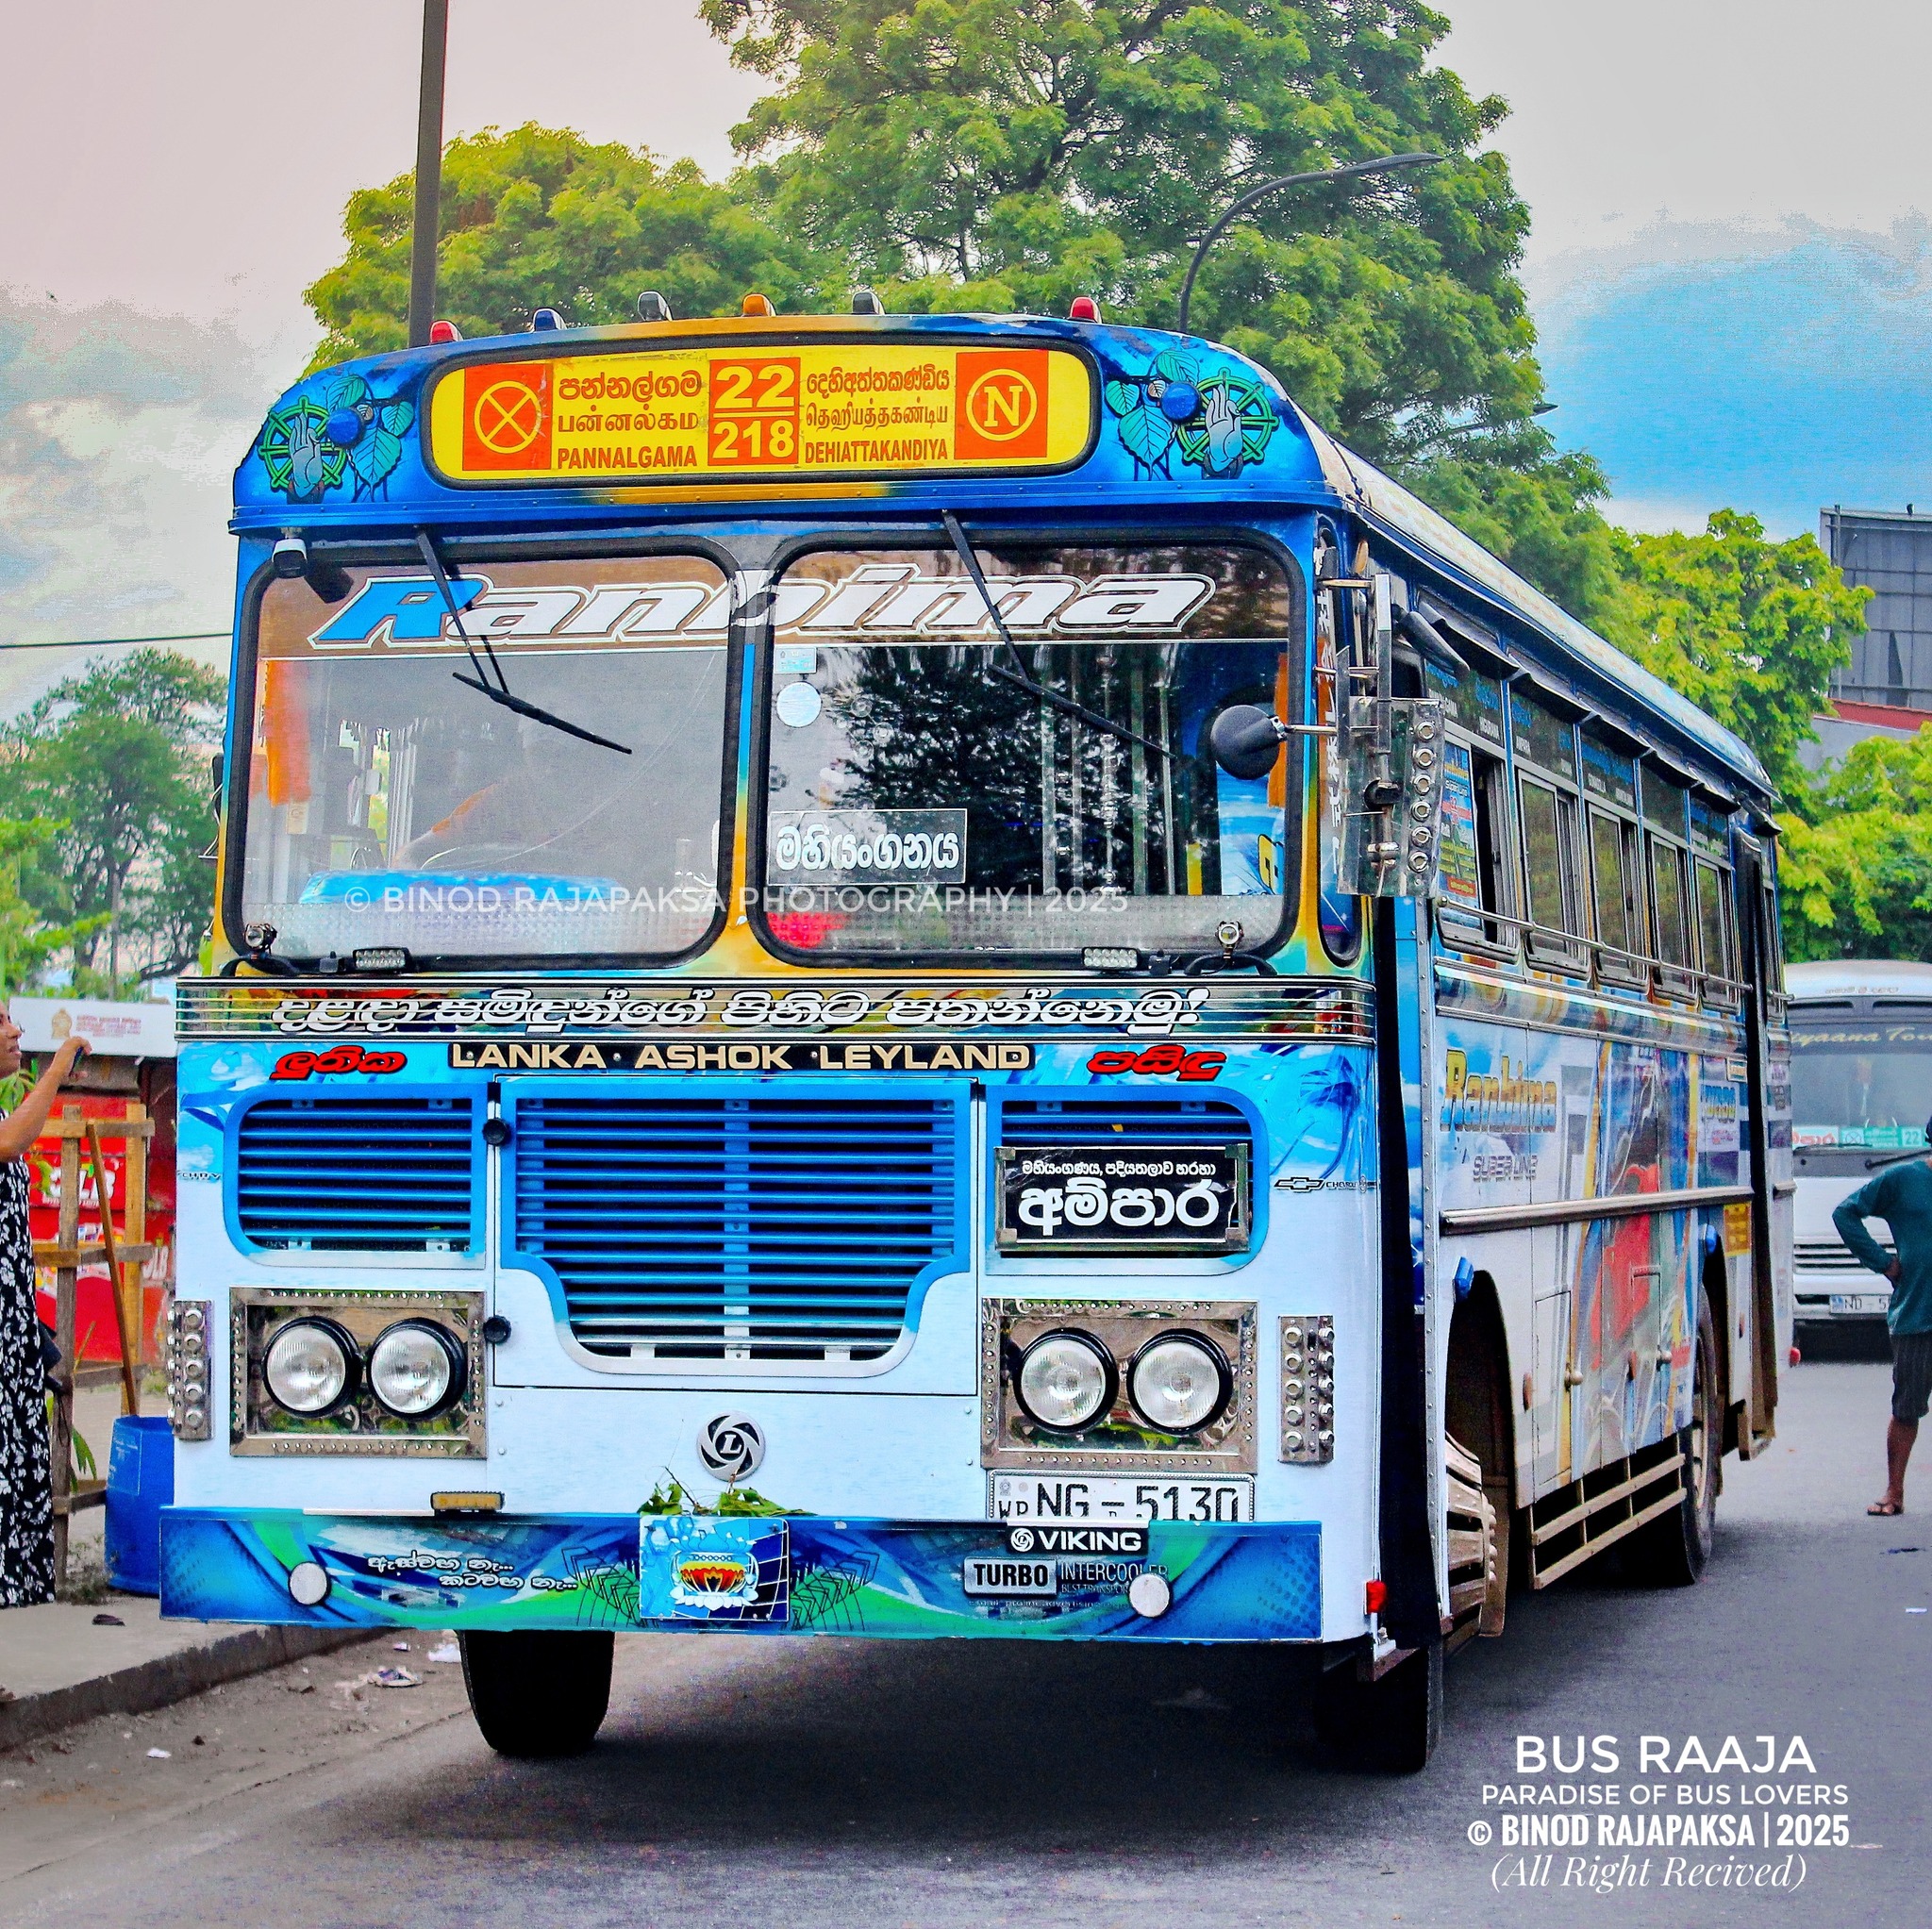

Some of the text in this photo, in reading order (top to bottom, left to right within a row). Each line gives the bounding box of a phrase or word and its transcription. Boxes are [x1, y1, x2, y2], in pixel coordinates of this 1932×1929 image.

[559, 370, 702, 402] පන්නල්ගම
[714, 365, 795, 408] 22
[558, 404, 699, 432] பன்னல்கம
[712, 420, 794, 458] 218
[806, 439, 947, 463] DEHIATTAKANDIYA
[558, 446, 697, 469] PANNALGAMA
[775, 823, 960, 871] මහියංගනය
[453, 1043, 1030, 1070] LANKA ASHOK LEYLAND
[1018, 1177, 1220, 1236] අම්පාර
[1038, 1530, 1142, 1553] VIKING
[974, 1563, 1049, 1588] TURBO
[1083, 1583, 1130, 1595] TRANSPOR
